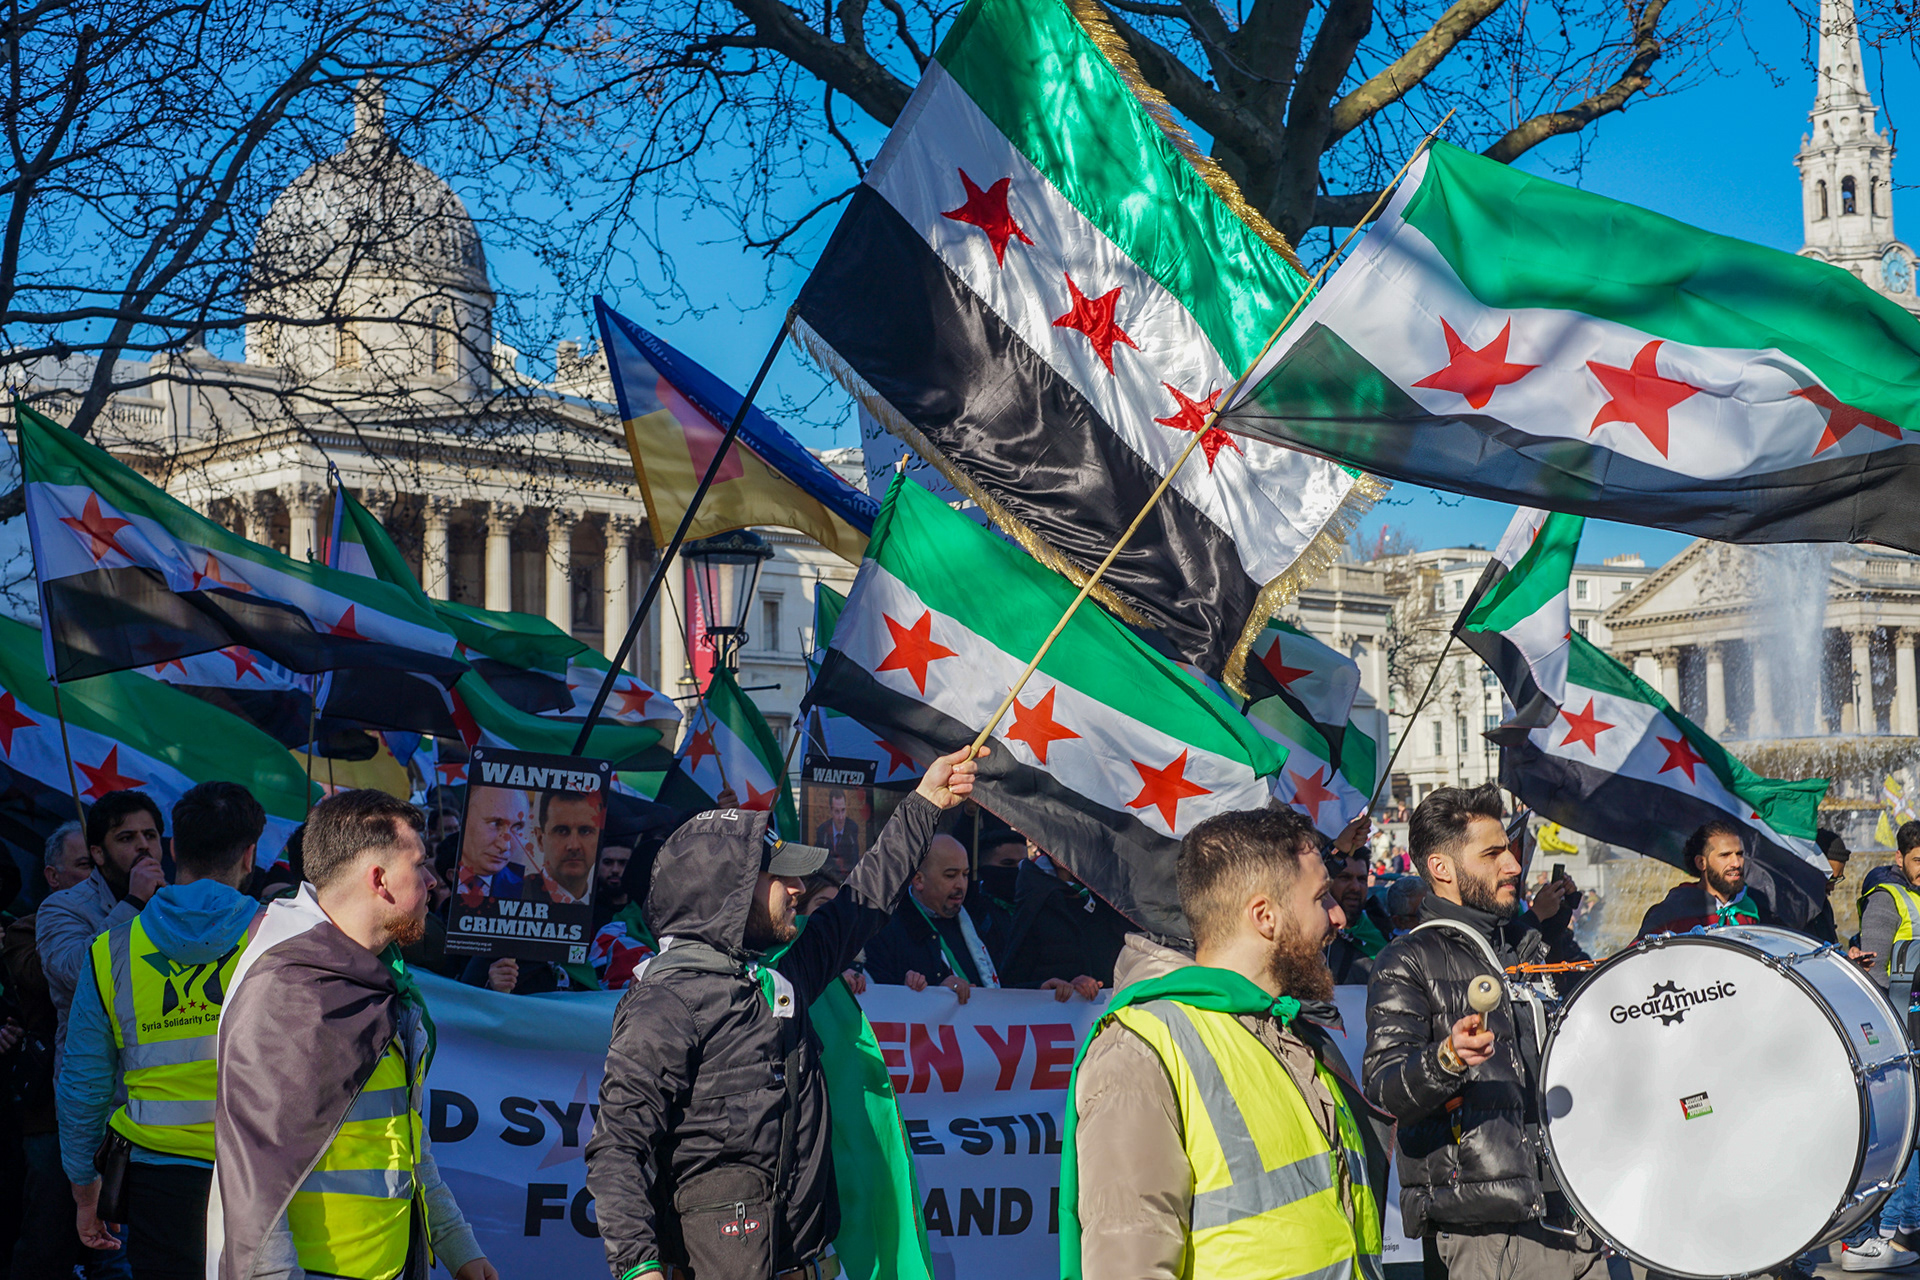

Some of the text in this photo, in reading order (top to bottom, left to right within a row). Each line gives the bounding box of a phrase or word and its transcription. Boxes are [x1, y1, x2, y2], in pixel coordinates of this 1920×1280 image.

[481, 761, 602, 793] WANTED
[813, 767, 866, 786] WANTED
[498, 901, 550, 919] WAR
[458, 915, 583, 940] CRIMINALS
[1610, 980, 1737, 1024] Gear4music
[141, 1022, 162, 1032] Syria
[164, 1015, 203, 1028] Solidarity
[870, 1021, 1076, 1094] EN YE
[429, 1088, 1064, 1156] D SY E STIL
[524, 1183, 601, 1239] FO
[923, 1187, 1034, 1237] AND
[1383, 1242, 1400, 1253] paign
